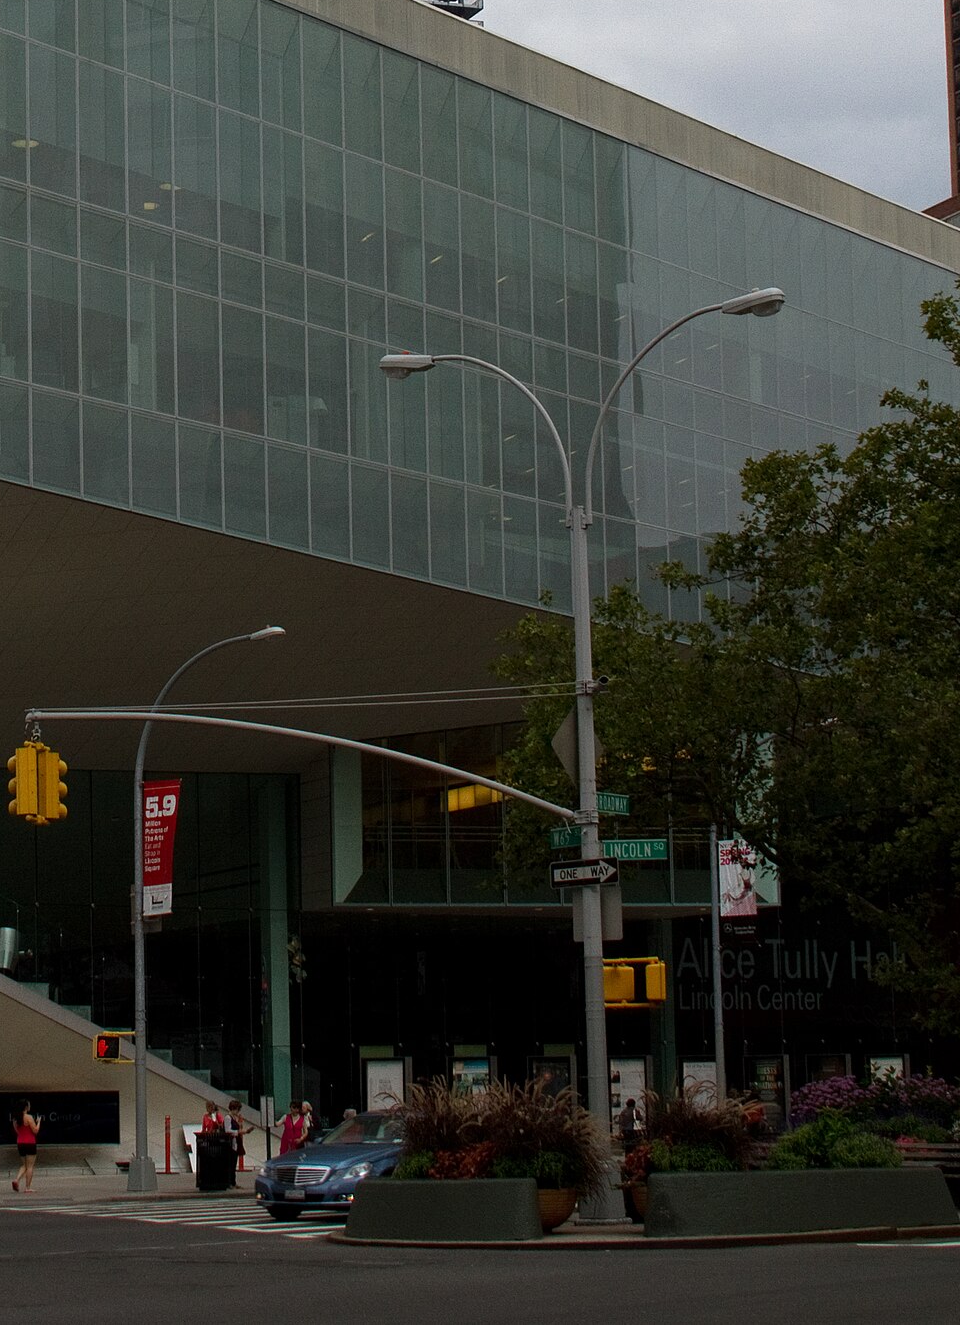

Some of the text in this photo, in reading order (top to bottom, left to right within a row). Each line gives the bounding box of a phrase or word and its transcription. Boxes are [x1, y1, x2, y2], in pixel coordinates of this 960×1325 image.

[145, 794, 177, 819] 5.9
[597, 794, 628, 812] ROADWAY
[603, 842, 664, 858] LINCOLN SQ
[559, 865, 610, 880] ONE WAY
[676, 937, 755, 979] Alce
[764, 938, 838, 989] Tully
[757, 984, 824, 1011] Center
